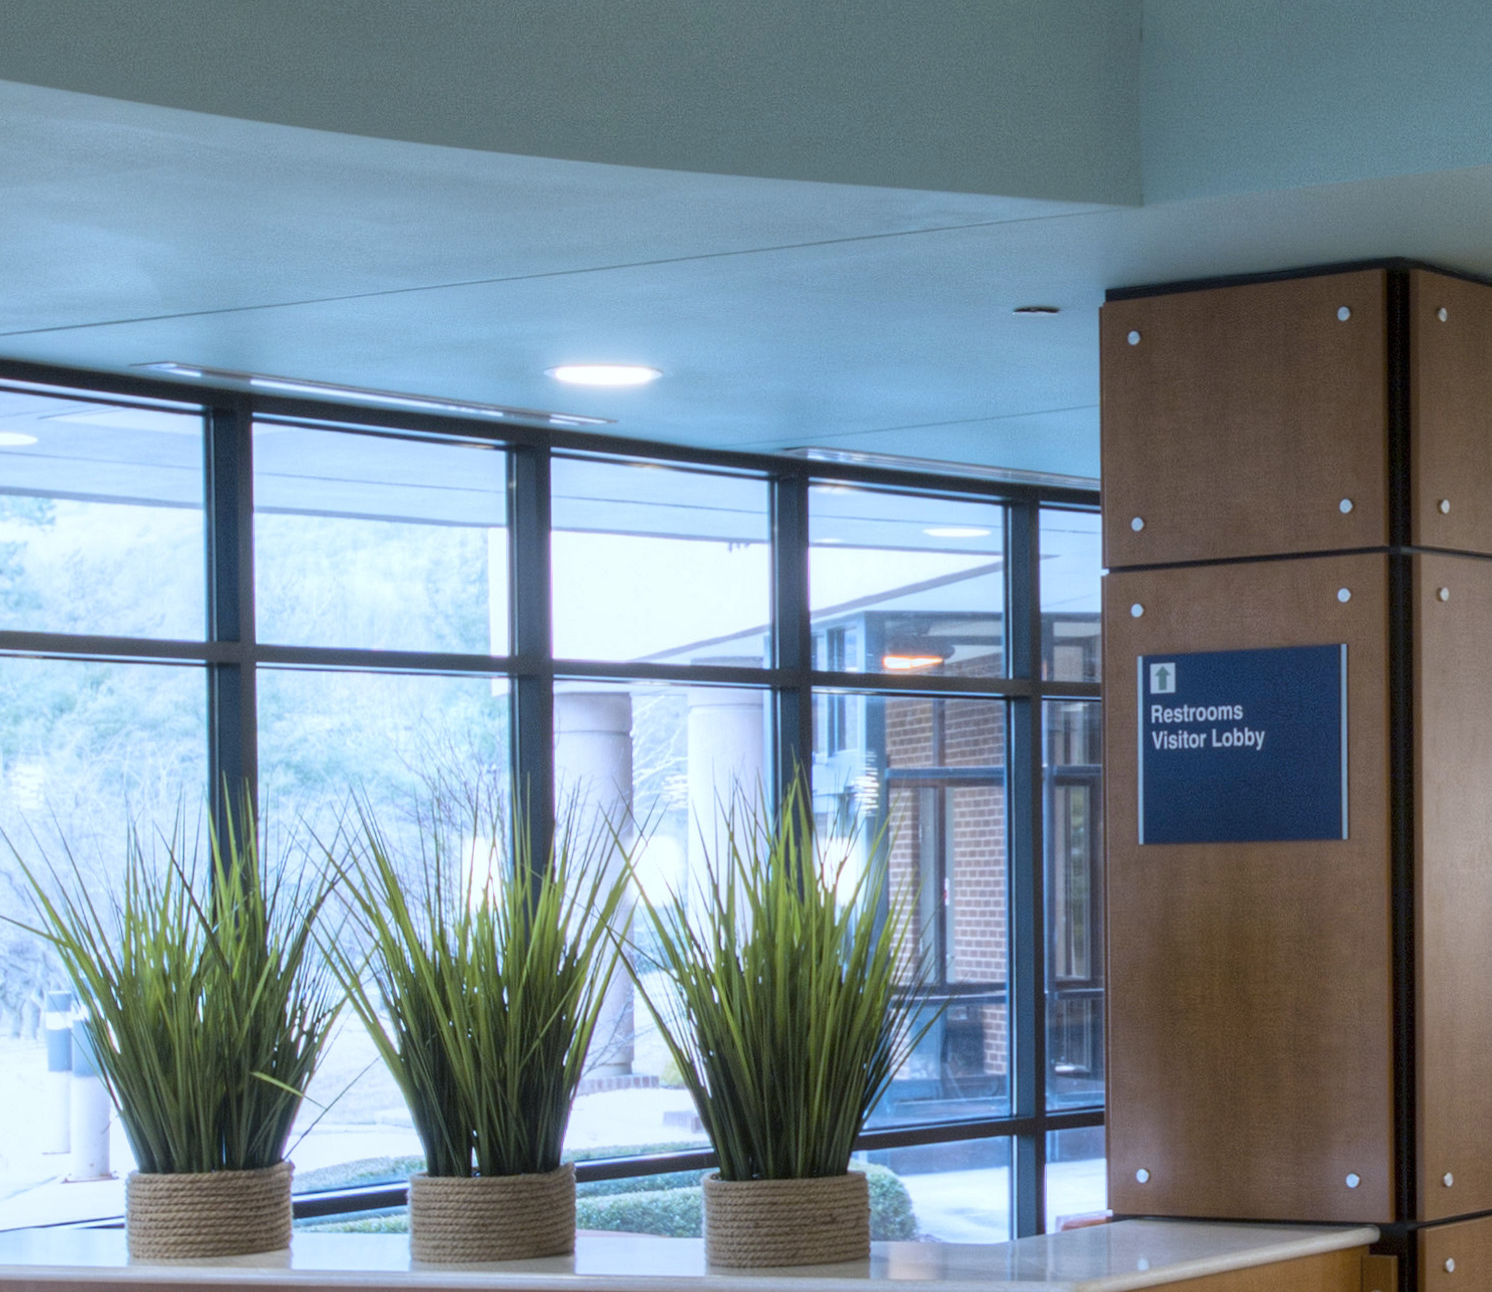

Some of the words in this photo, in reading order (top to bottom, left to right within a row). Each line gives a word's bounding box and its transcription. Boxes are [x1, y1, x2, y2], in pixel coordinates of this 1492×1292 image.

[1151, 704, 1243, 724] Restrooms
[1151, 730, 1206, 749] Visitor
[1211, 727, 1265, 750] Lobby
